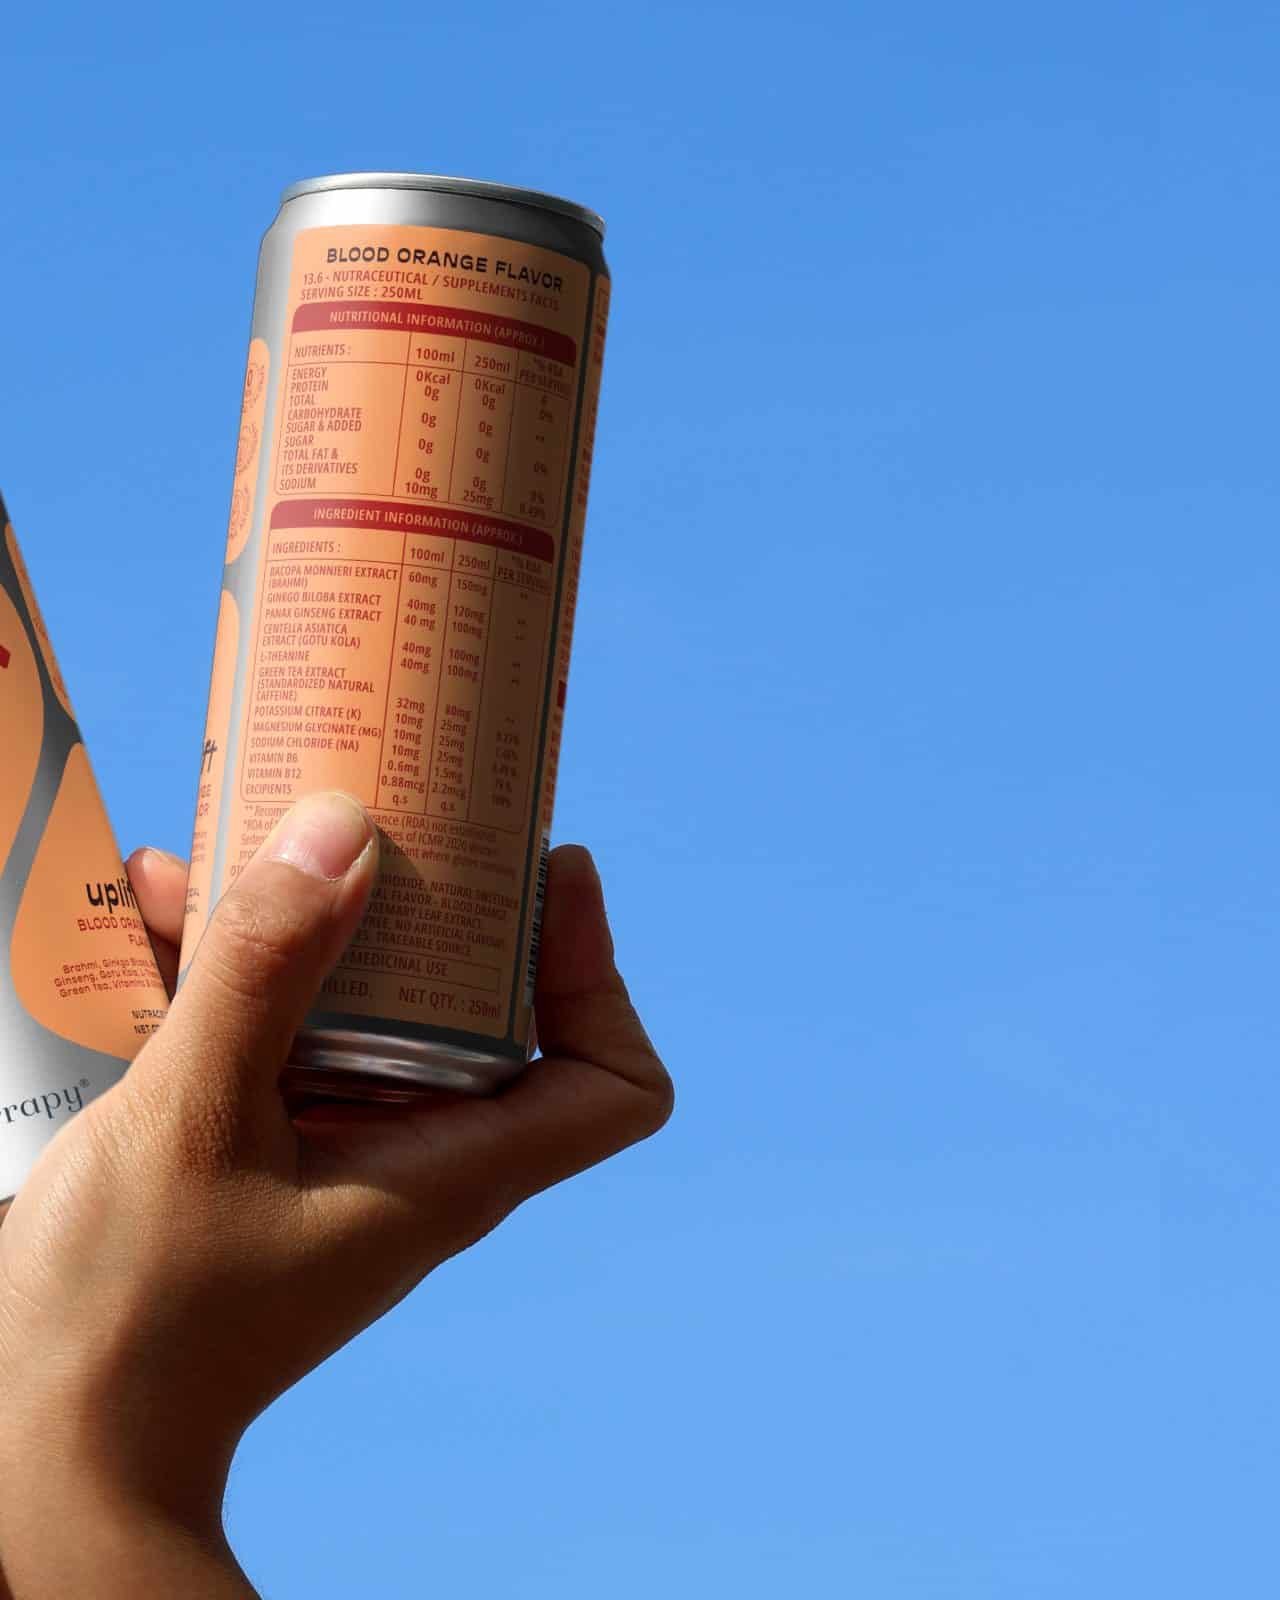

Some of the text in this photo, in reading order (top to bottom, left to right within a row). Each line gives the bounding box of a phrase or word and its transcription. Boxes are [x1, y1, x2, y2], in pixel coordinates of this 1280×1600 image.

[326, 247, 562, 292] BLOOD ORANGE FLAVOR
[331, 270, 426, 285] NUTRACEUTICAL
[300, 285, 424, 300] SERVING SIZE 250ML
[329, 310, 491, 336] NUTRITIONAL INFORMATION
[294, 344, 510, 374] NUTRIENTS 100ml 250ml
[291, 366, 505, 395] ENERGY 0Kcal 0Kcal
[290, 380, 495, 410] PROTEIN 0g 0g
[287, 408, 361, 420] CARBOHYDRATE
[286, 421, 361, 433] SUGAR ADDED
[284, 435, 489, 462] SUGAR 0g 0g
[295, 462, 357, 474] DERIVATIVES
[279, 478, 492, 508] SODIUM 10mg 25mg
[313, 508, 468, 534] INGREDIENT INFORMATION
[272, 541, 444, 563] INGREDIENTS 100ml
[303, 565, 438, 587] MONNIERI EXTRACT 60mg
[301, 591, 436, 614] BILOBA EXTRACT 40mg
[294, 608, 381, 622] GINSENG EXTRACT
[330, 635, 431, 657] KOLA) 40mg
[399, 657, 429, 673] 40mg
[327, 679, 374, 693] NATURAL
[396, 697, 425, 713] 32mg
[304, 706, 423, 729] CITRATE (K) 10mg
[305, 722, 421, 745] GLYCINATE (MG) 10mg
[286, 737, 420, 760] CHLORIDE (NA) 10mg
[387, 759, 419, 776] 0.6mg
[77, 916, 118, 931] BLOOD
[348, 951, 448, 977] MEDICINAL USE
[399, 987, 426, 1005] NET
